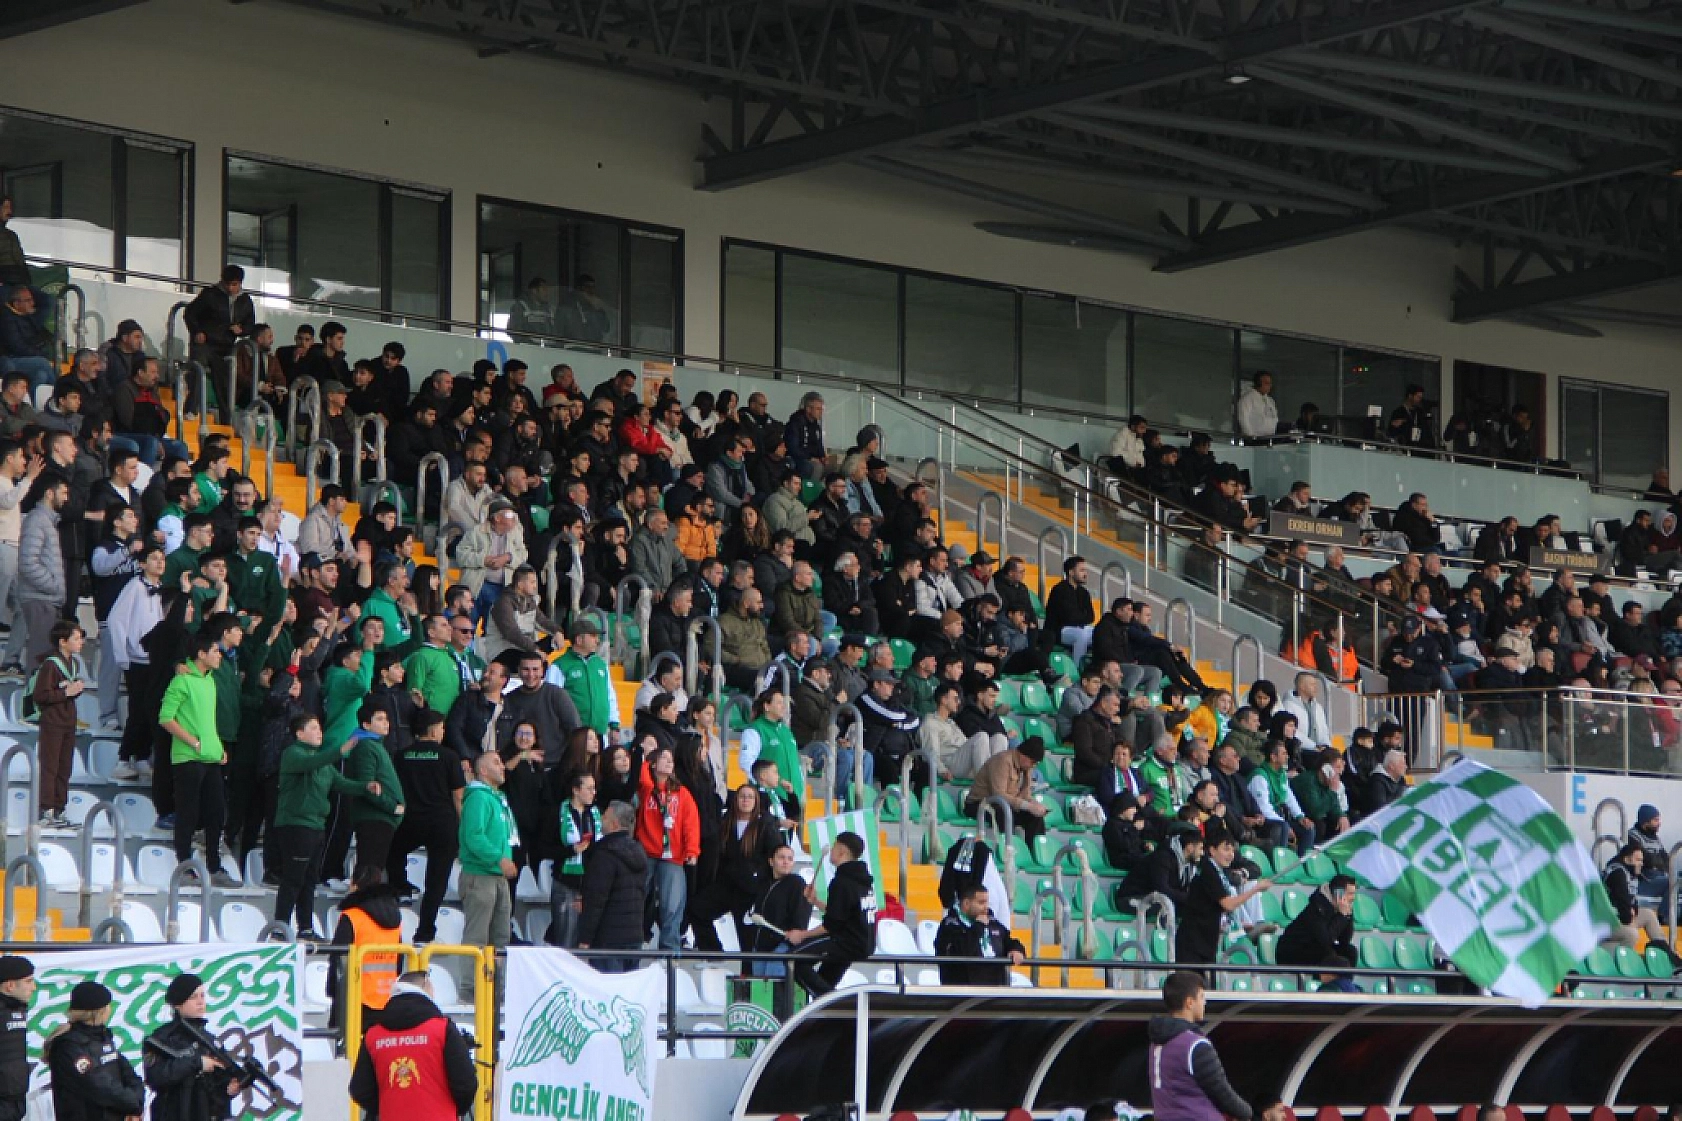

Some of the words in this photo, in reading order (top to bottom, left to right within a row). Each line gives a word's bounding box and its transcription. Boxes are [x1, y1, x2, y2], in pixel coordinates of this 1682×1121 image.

[1572, 775, 1586, 814] E
[375, 1037, 398, 1049] SPOR
[509, 1081, 601, 1121] GENÇLİK
